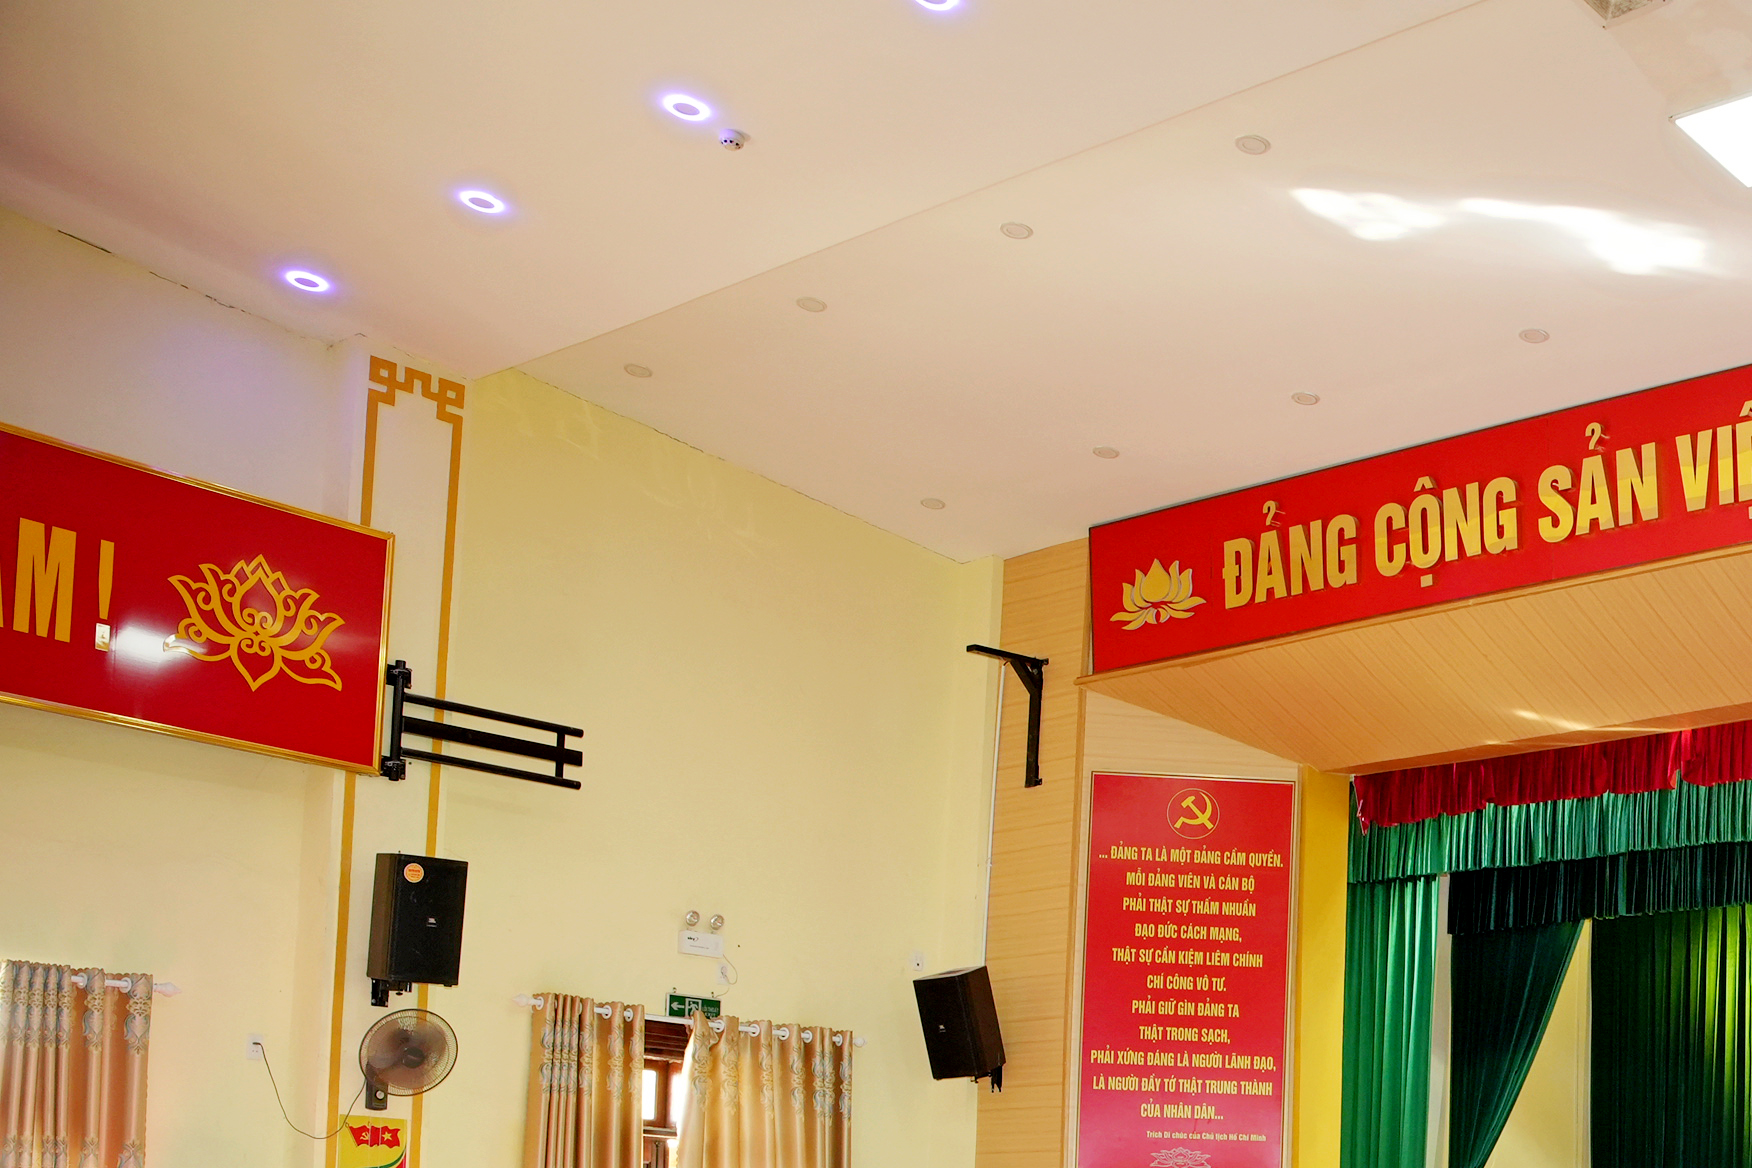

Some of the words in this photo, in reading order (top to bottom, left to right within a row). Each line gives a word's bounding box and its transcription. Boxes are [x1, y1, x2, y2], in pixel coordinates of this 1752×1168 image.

[1223, 501, 1356, 608] ĐẢNG
[1375, 476, 1517, 587] CỘNG
[1538, 423, 1658, 542] SẢN
[0, 517, 77, 643] M
[1111, 841, 1138, 860] ĐẢNG
[1141, 848, 1152, 861] TA
[1156, 846, 1167, 861] LÀ
[1170, 847, 1191, 865] MỘT
[1194, 845, 1220, 864] ĐẢNG
[1135, 924, 1154, 939] ĐẠO
[1158, 921, 1177, 938] ĐỨC
[1181, 923, 1207, 939] CÁCH
[1210, 927, 1242, 943] MẠNG,
[1147, 973, 1163, 988] CHÍ
[1167, 974, 1193, 990] CÔNG
[1197, 975, 1208, 990] VÔ
[1139, 1024, 1163, 1042] THẬT
[1166, 1027, 1198, 1041] TRONG
[1201, 1029, 1230, 1045] SẠCH,
[1091, 1045, 1114, 1063] PHẢI
[1117, 1048, 1144, 1065] XỨNG
[1147, 1050, 1174, 1066] ĐÁNG
[1178, 1051, 1189, 1066] LÀ
[1192, 1051, 1222, 1068] NGƯỜI
[1225, 1053, 1251, 1069] LÃNH
[1254, 1056, 1276, 1072] ĐẠO,
[1141, 1098, 1161, 1117] CỦA
[1164, 1102, 1191, 1118] NHÂN
